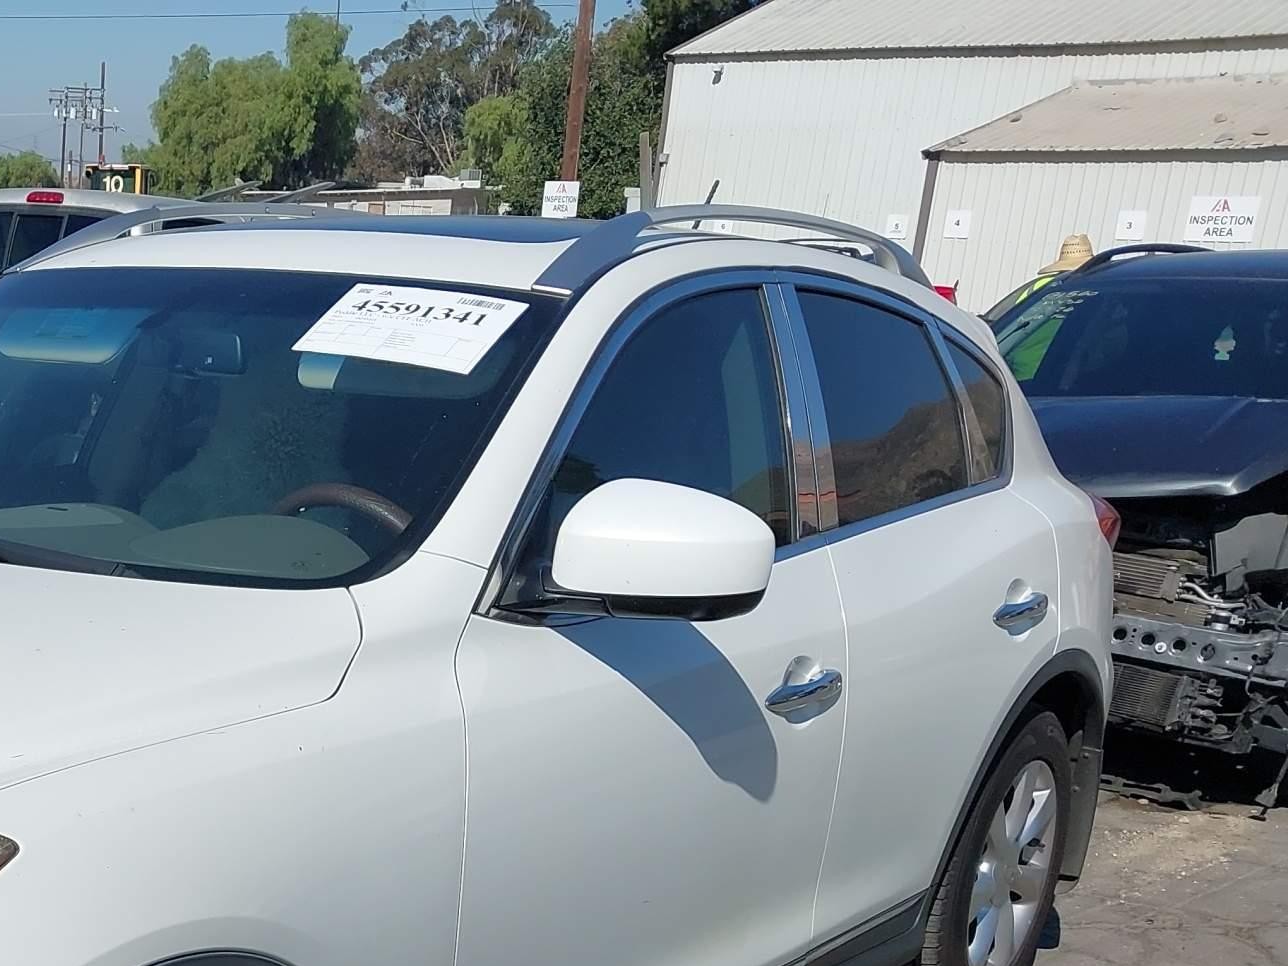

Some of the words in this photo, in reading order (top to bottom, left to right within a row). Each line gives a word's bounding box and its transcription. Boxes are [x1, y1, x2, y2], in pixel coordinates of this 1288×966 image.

[102, 175, 124, 193] 10
[544, 195, 577, 203] INSPECTION
[552, 205, 569, 213] AREA
[954, 219, 961, 227] 4
[1188, 215, 1254, 226] INSPECTION
[1126, 221, 1133, 230] 3
[1203, 227, 1233, 237] AREA
[351, 299, 488, 326] 45591341
